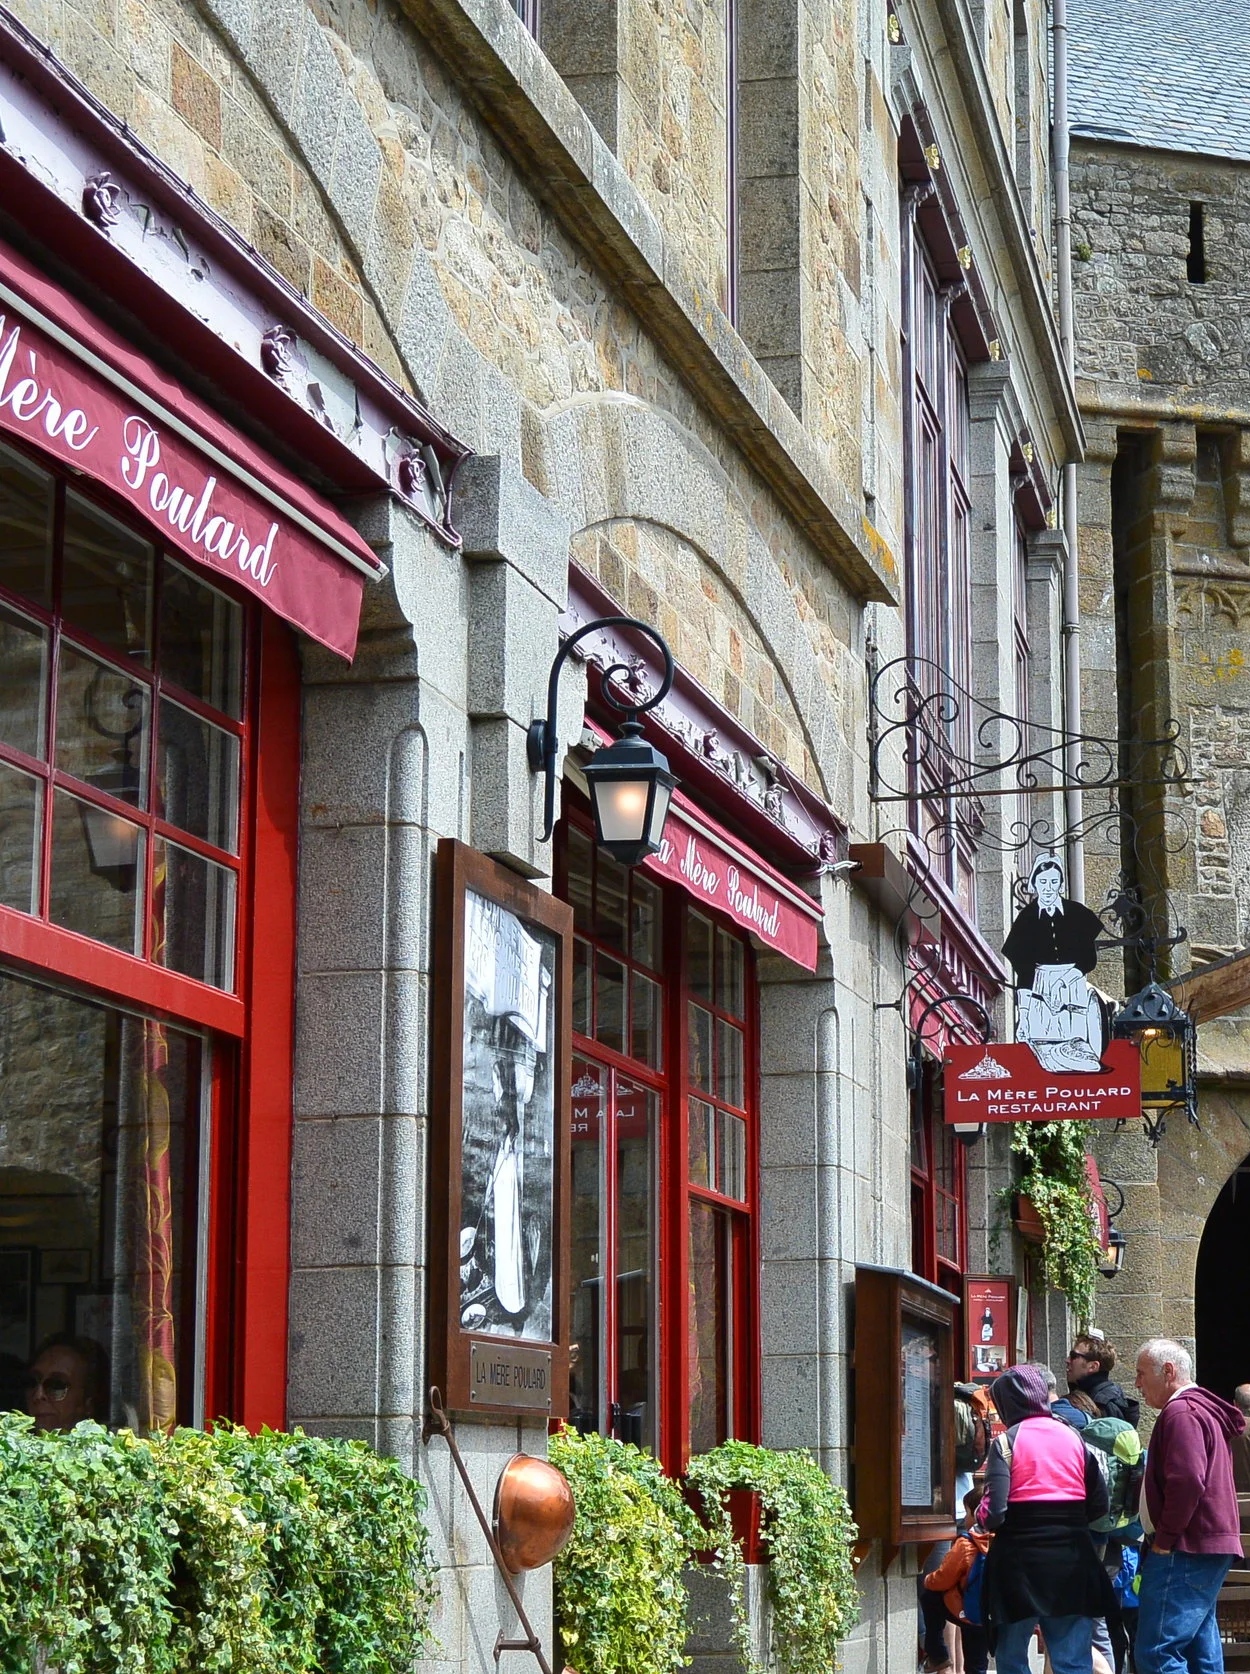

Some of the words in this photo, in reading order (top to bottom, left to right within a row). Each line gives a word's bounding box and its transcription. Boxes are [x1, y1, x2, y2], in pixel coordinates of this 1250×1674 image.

[122, 415, 279, 587] Poulard
[652, 838, 675, 864] a
[680, 834, 721, 894] Mère
[727, 865, 781, 938] Poulard
[957, 1090, 980, 1102] LA
[987, 1088, 1038, 1101] MÈRE
[1045, 1086, 1132, 1099] POULARD
[988, 1100, 1101, 1115] RESTAURANT
[476, 1361, 487, 1384] LA
[513, 1365, 546, 1390] POULARD
